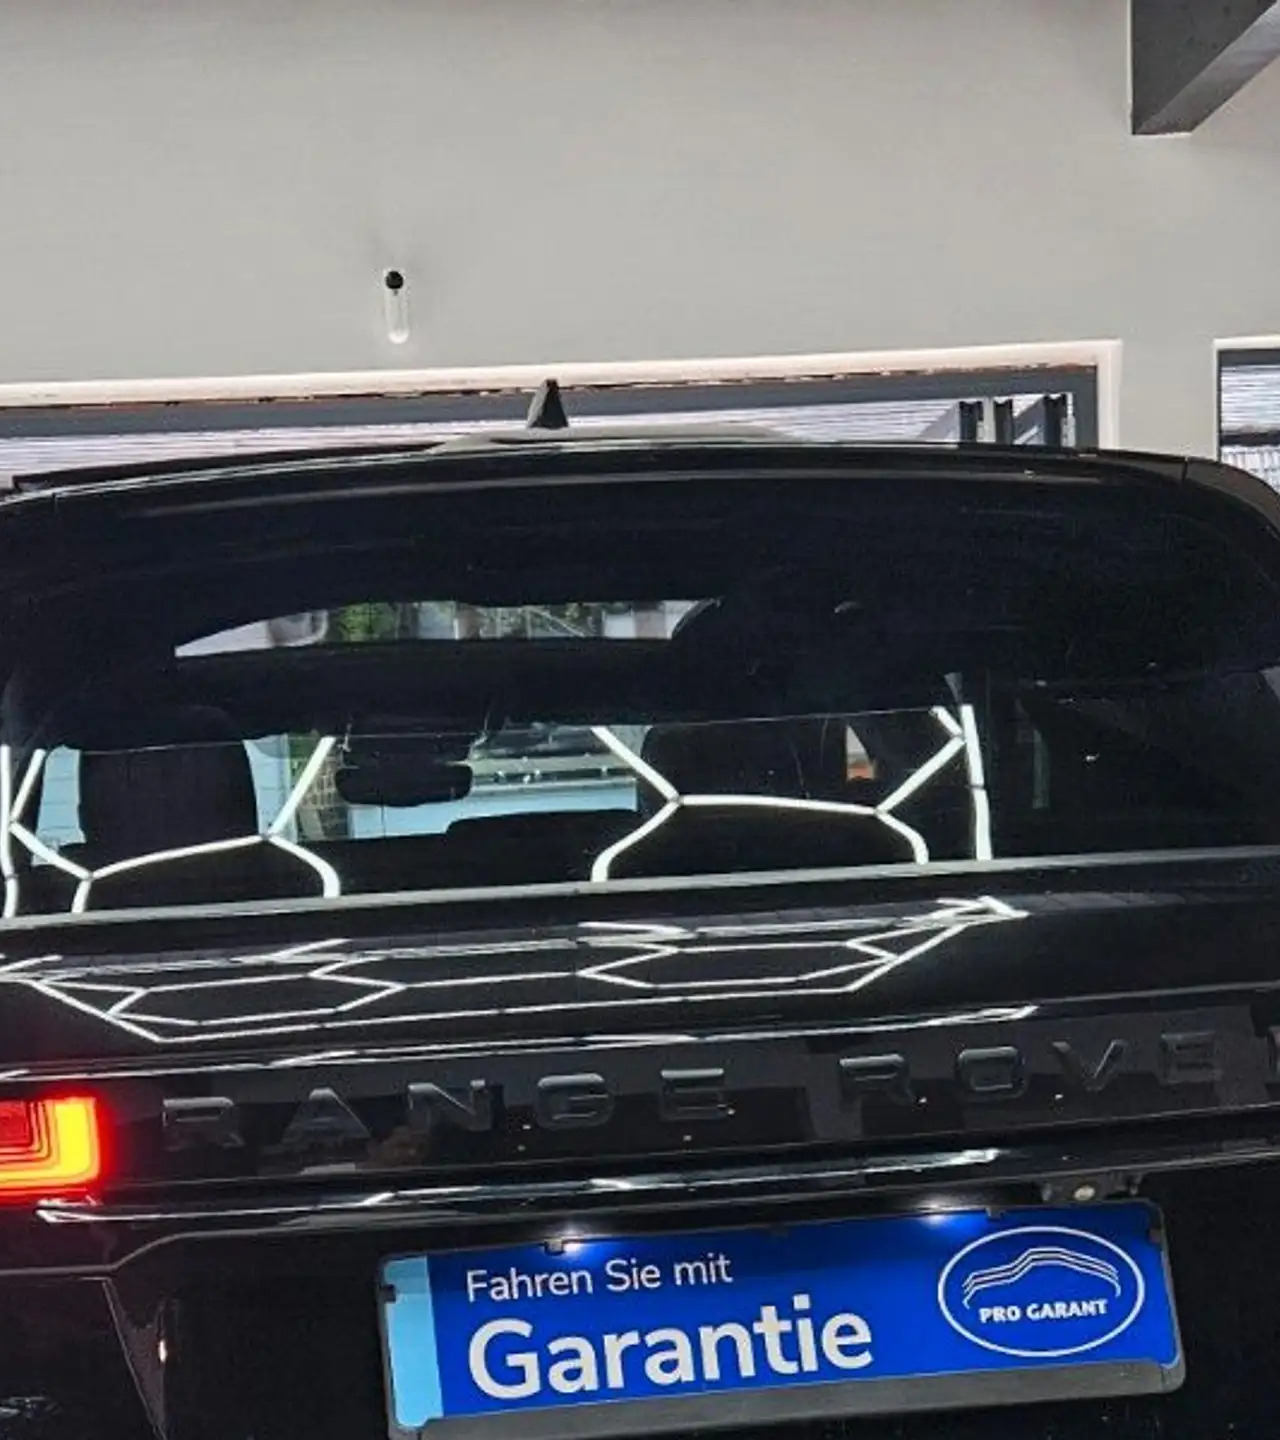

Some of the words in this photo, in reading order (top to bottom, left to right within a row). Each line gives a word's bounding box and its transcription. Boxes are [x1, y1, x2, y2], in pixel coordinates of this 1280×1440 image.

[161, 1067, 727, 1150] RANGE
[467, 1268, 593, 1302] Fahren
[606, 1259, 661, 1291] Sie
[673, 1253, 733, 1286] mit
[978, 1305, 1022, 1324] PRO
[1025, 1299, 1107, 1321] GARANT
[468, 1293, 873, 1399] Garantie
